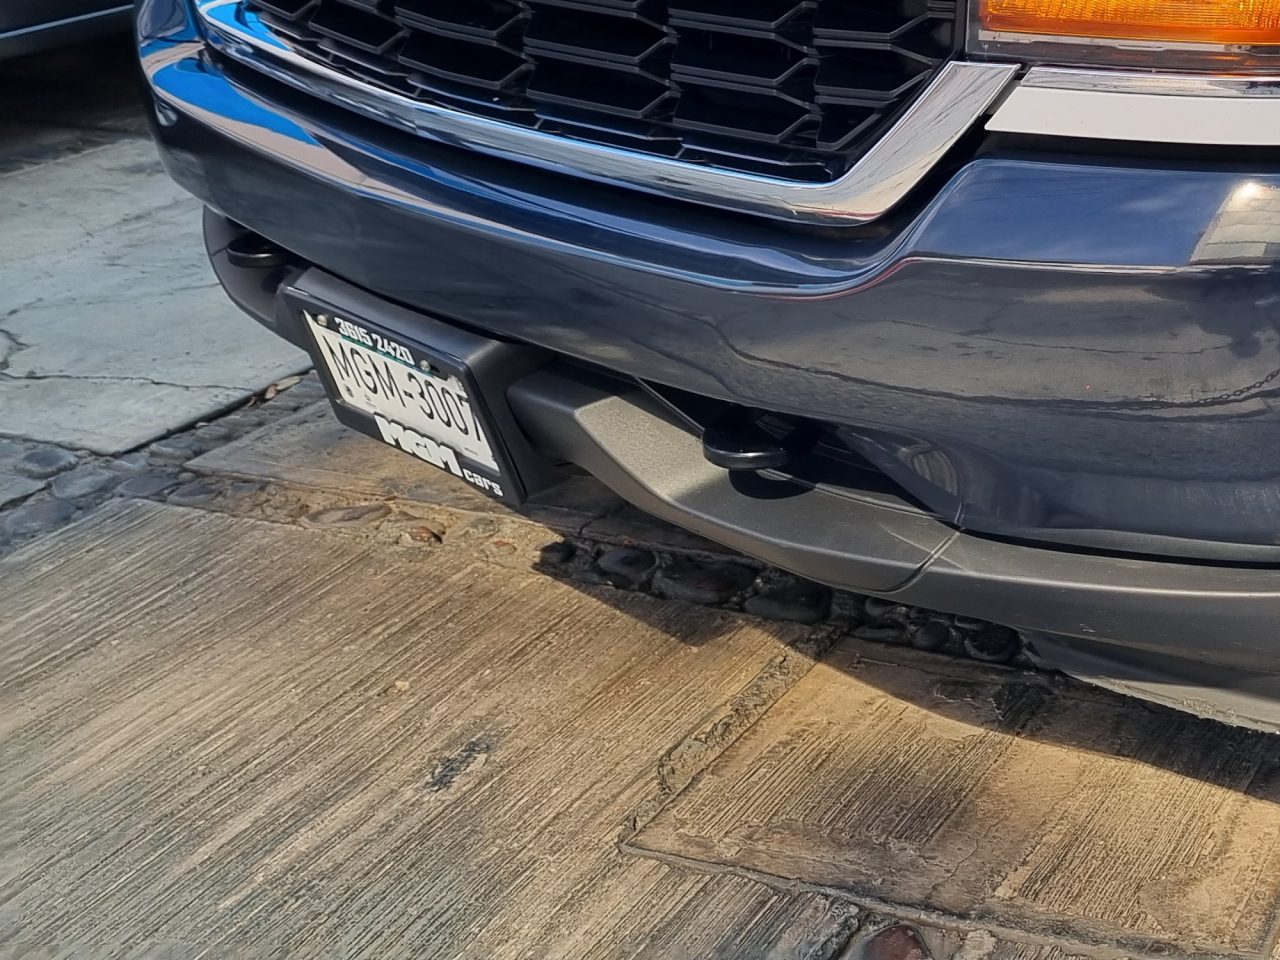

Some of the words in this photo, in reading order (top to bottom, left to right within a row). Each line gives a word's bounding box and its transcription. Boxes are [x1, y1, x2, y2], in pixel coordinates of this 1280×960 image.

[334, 316, 373, 347] 3615
[371, 332, 415, 366] 2420
[374, 413, 463, 478] MGM
[462, 469, 504, 497] cars
